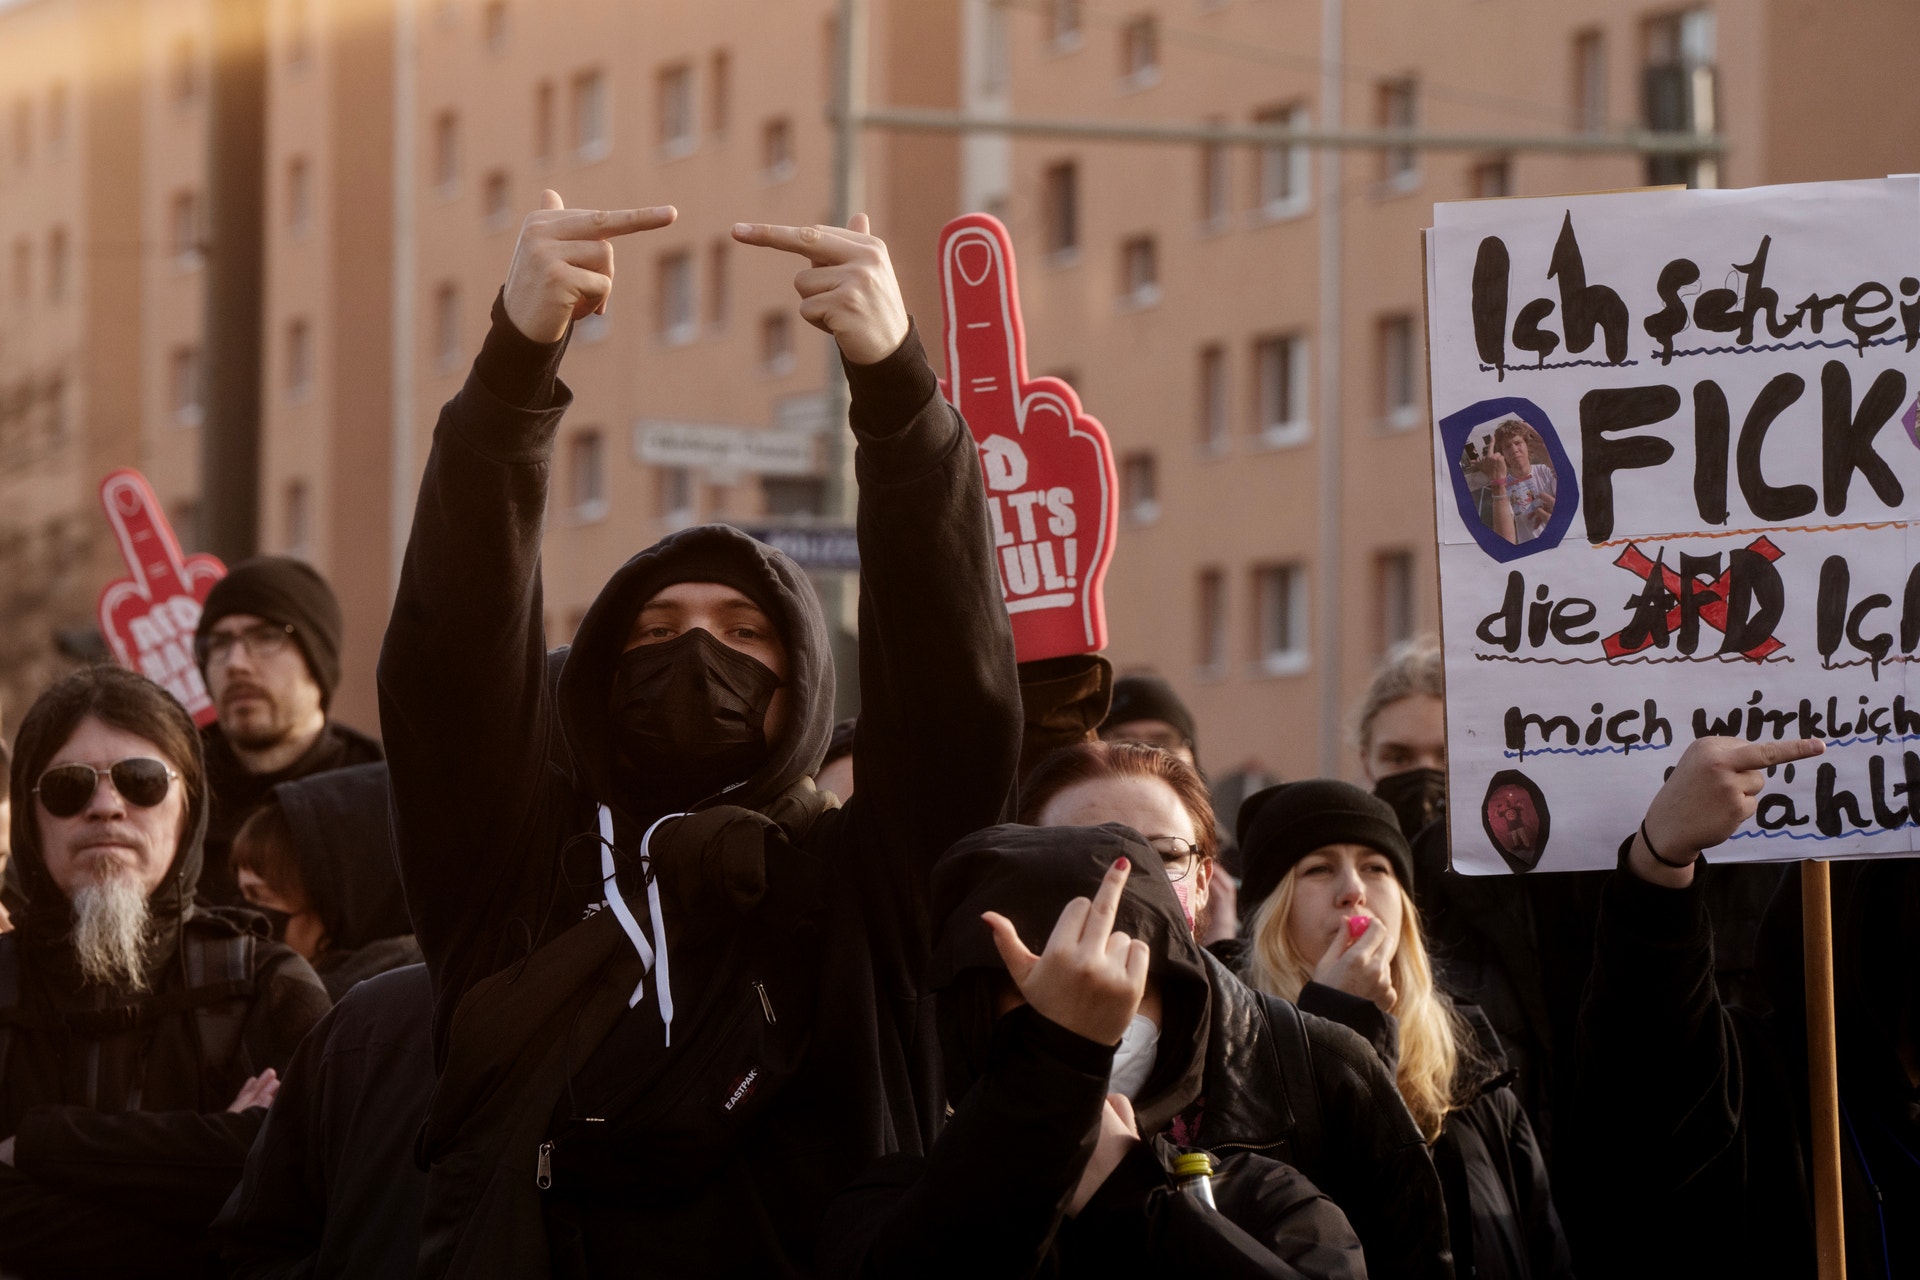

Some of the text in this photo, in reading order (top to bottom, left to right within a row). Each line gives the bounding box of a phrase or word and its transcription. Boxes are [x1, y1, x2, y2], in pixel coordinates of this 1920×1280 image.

[1472, 209, 1630, 381] Ich
[1580, 360, 1907, 544] FICK
[1000, 538, 1078, 598] UL!
[1476, 571, 1600, 653] die
[1504, 699, 1672, 762] mich
[724, 1069, 758, 1111] EASTPAK
